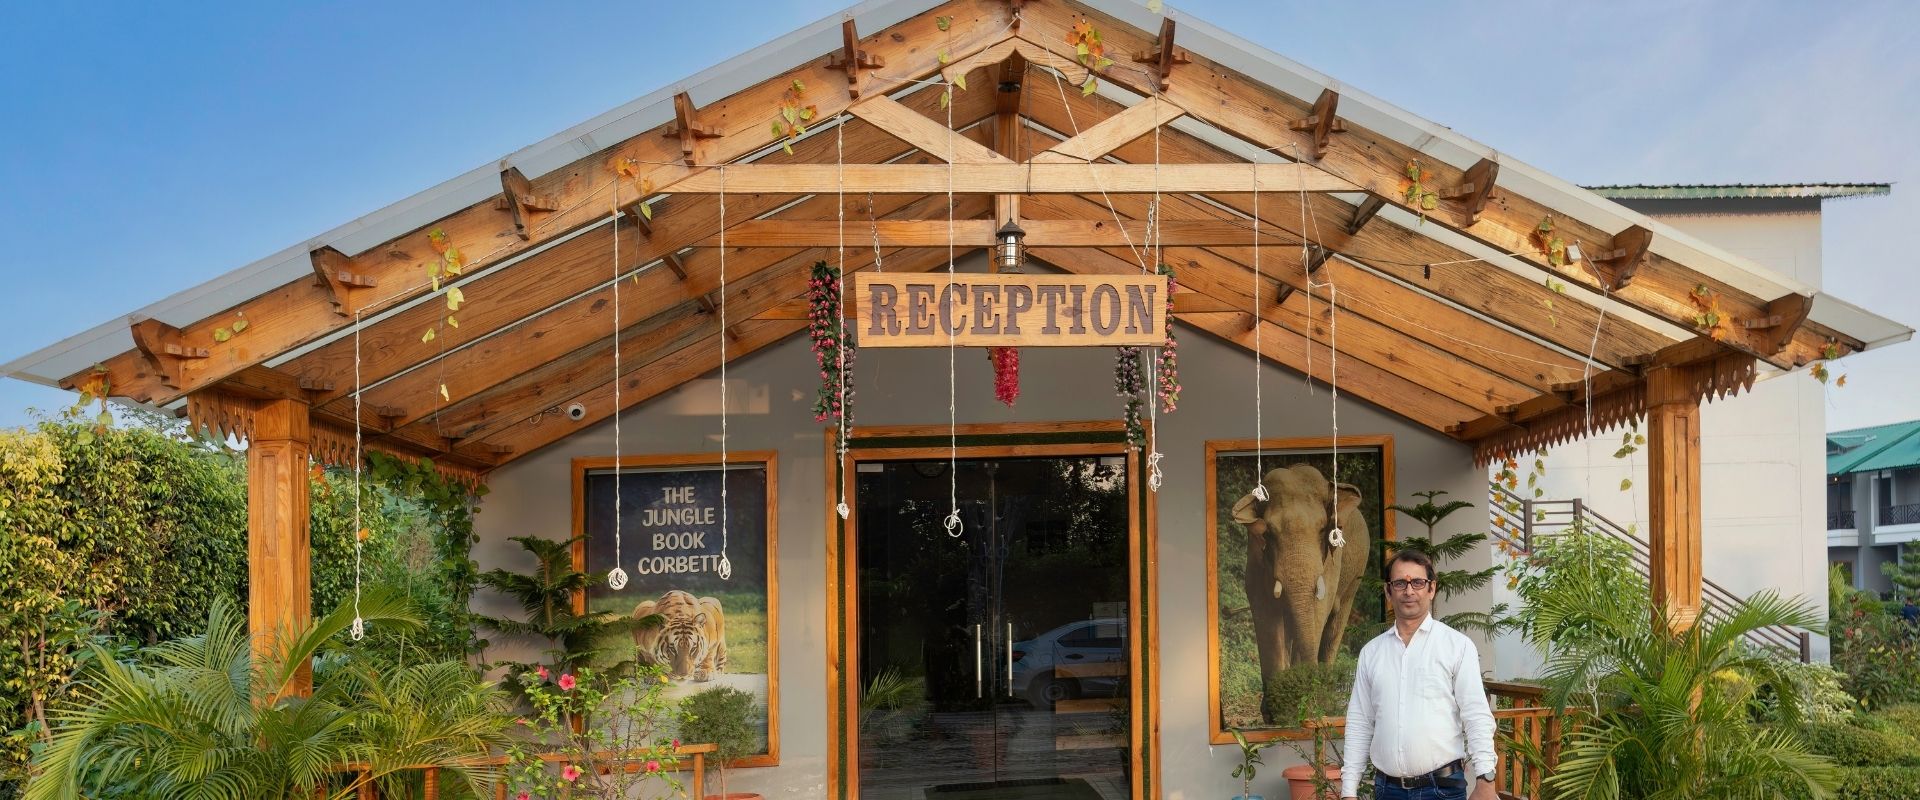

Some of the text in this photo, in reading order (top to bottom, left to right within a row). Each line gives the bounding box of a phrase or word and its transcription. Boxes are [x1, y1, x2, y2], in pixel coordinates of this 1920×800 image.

[867, 283, 1157, 337] RECEPTION
[662, 486, 696, 504] THE
[642, 507, 716, 527] JUNGLE
[652, 531, 705, 551] BOOK
[638, 554, 720, 575] CORBETT
